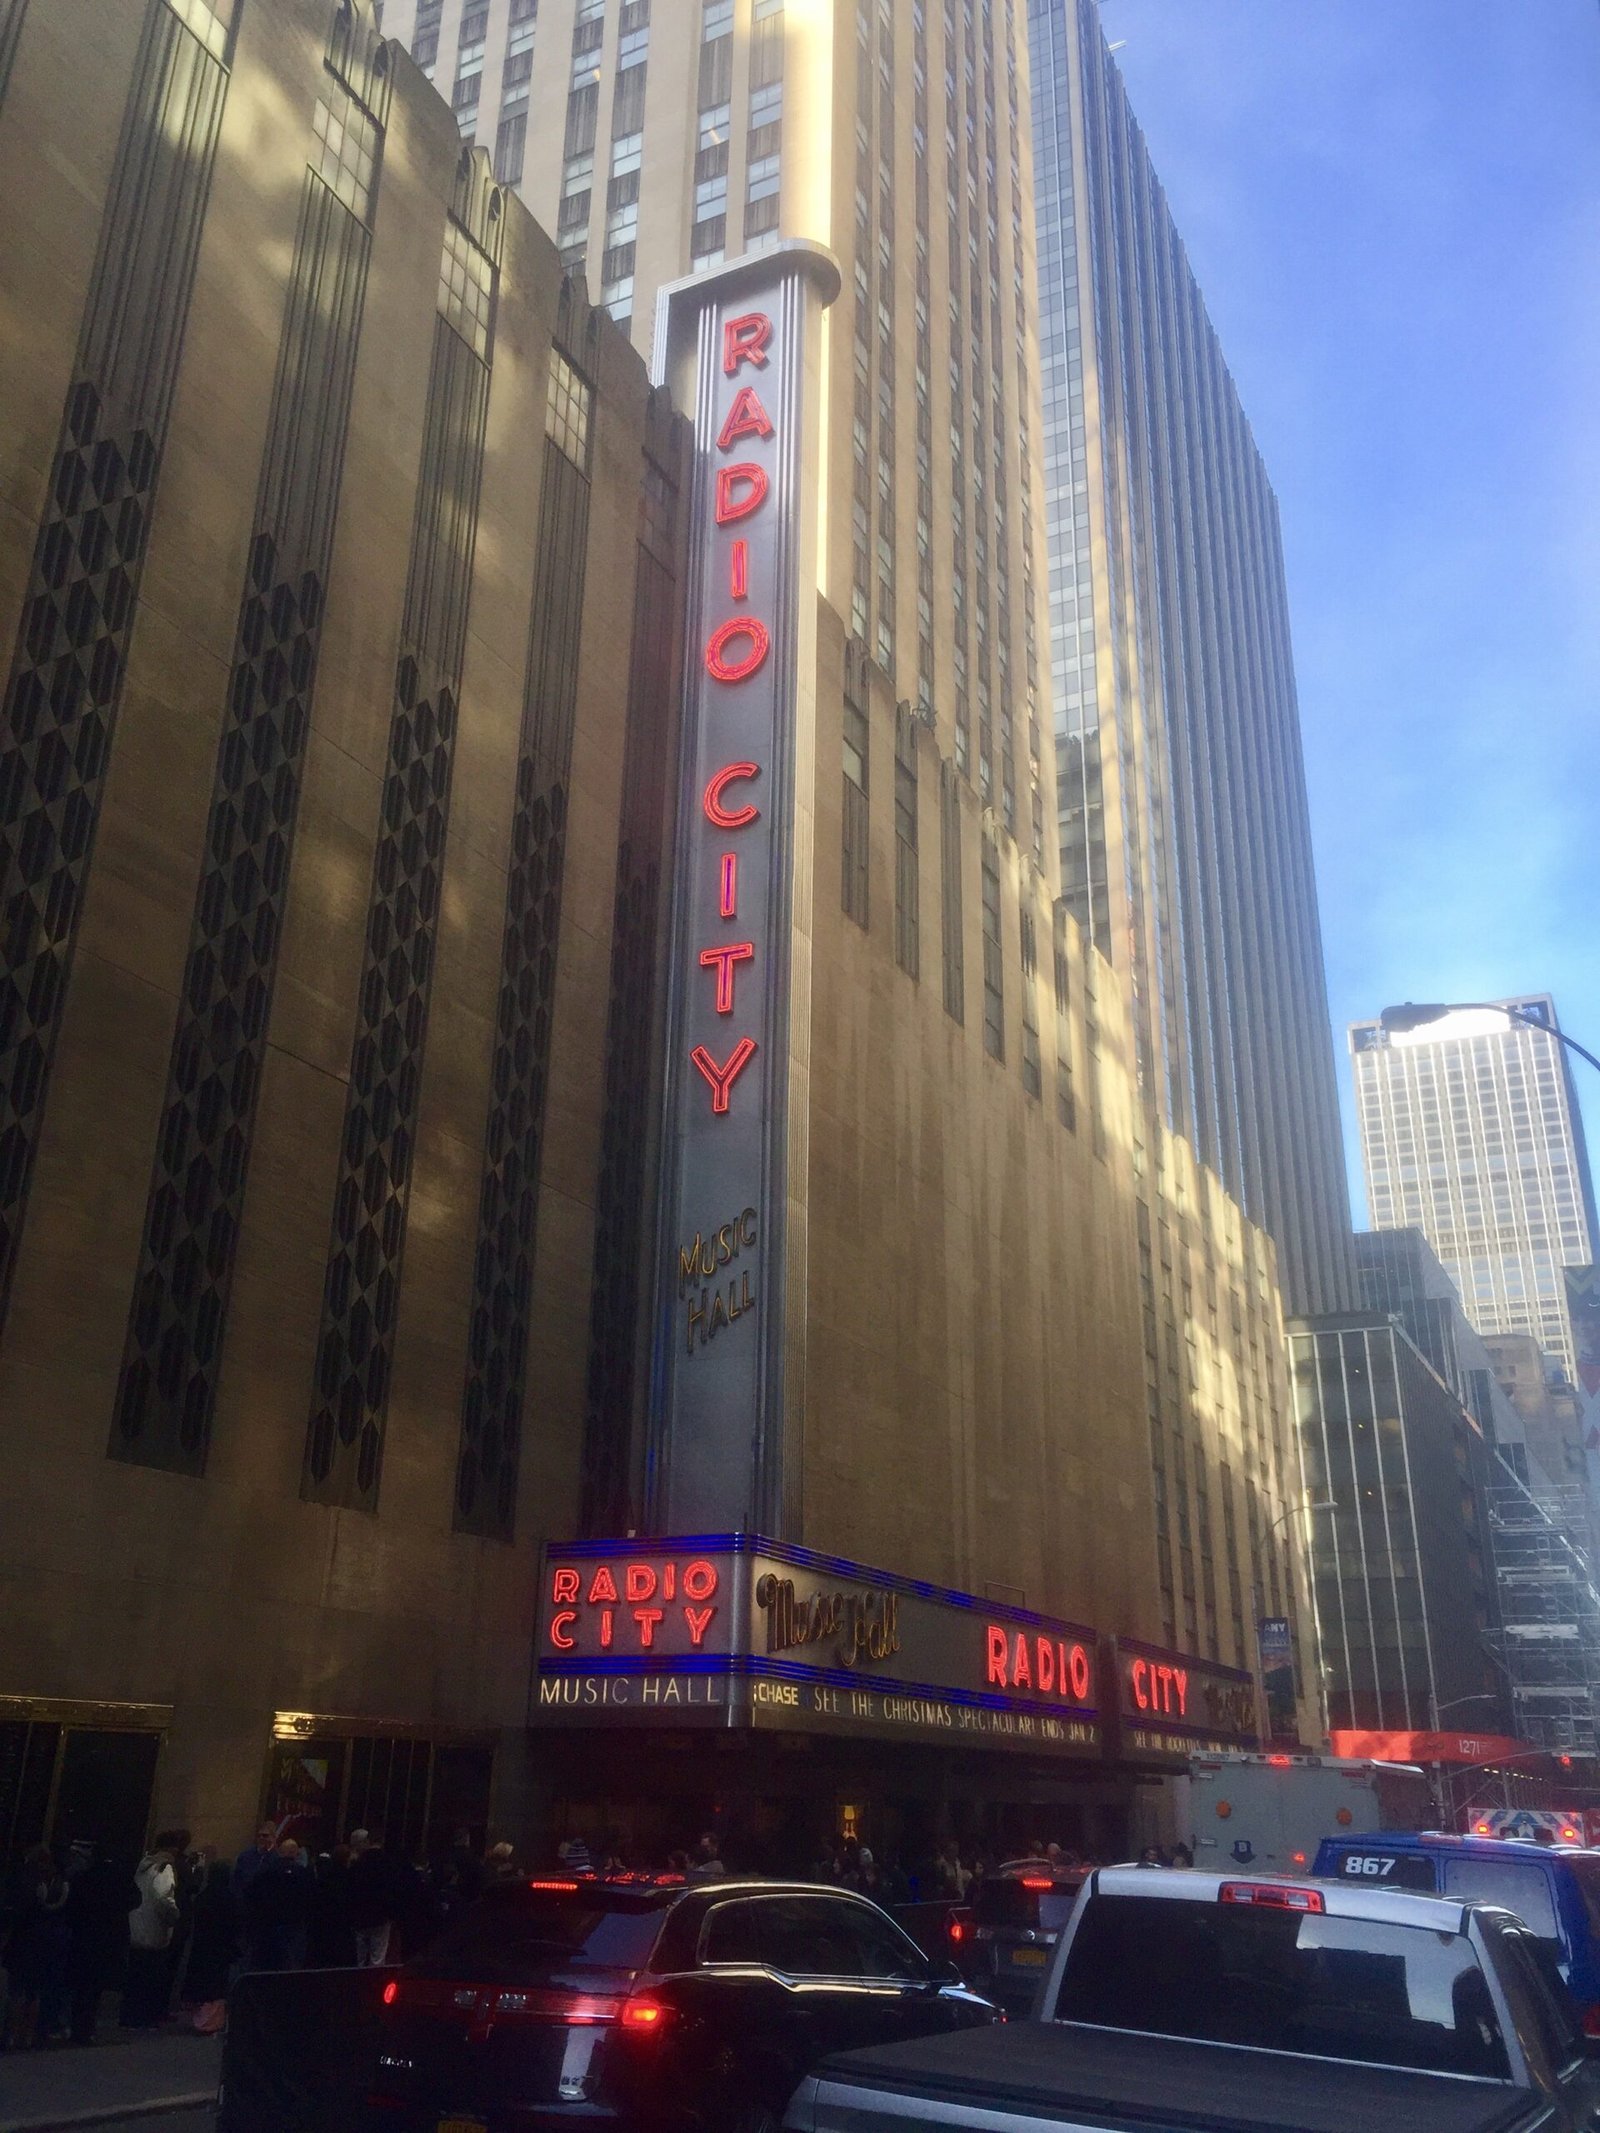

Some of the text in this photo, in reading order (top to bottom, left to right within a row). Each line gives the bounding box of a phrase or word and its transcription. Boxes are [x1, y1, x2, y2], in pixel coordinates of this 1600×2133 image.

[690, 312, 773, 1113] RADIO CITY
[679, 1208, 757, 1298] MUSIC
[687, 1270, 754, 1355] HALL
[553, 1560, 718, 1603] RADIO
[550, 1606, 717, 1649] CITY
[987, 1624, 1090, 1699] RADIO
[539, 1677, 721, 1704] MUSIC HALL
[758, 1683, 800, 1706] CHASE
[813, 1690, 840, 1714] SEE
[850, 1693, 874, 1717] THE
[883, 1699, 952, 1727] CHRISTMAS
[1132, 1658, 1188, 1715] CITY
[1459, 1740, 1480, 1756] 1271
[1345, 1857, 1396, 1876] 867
